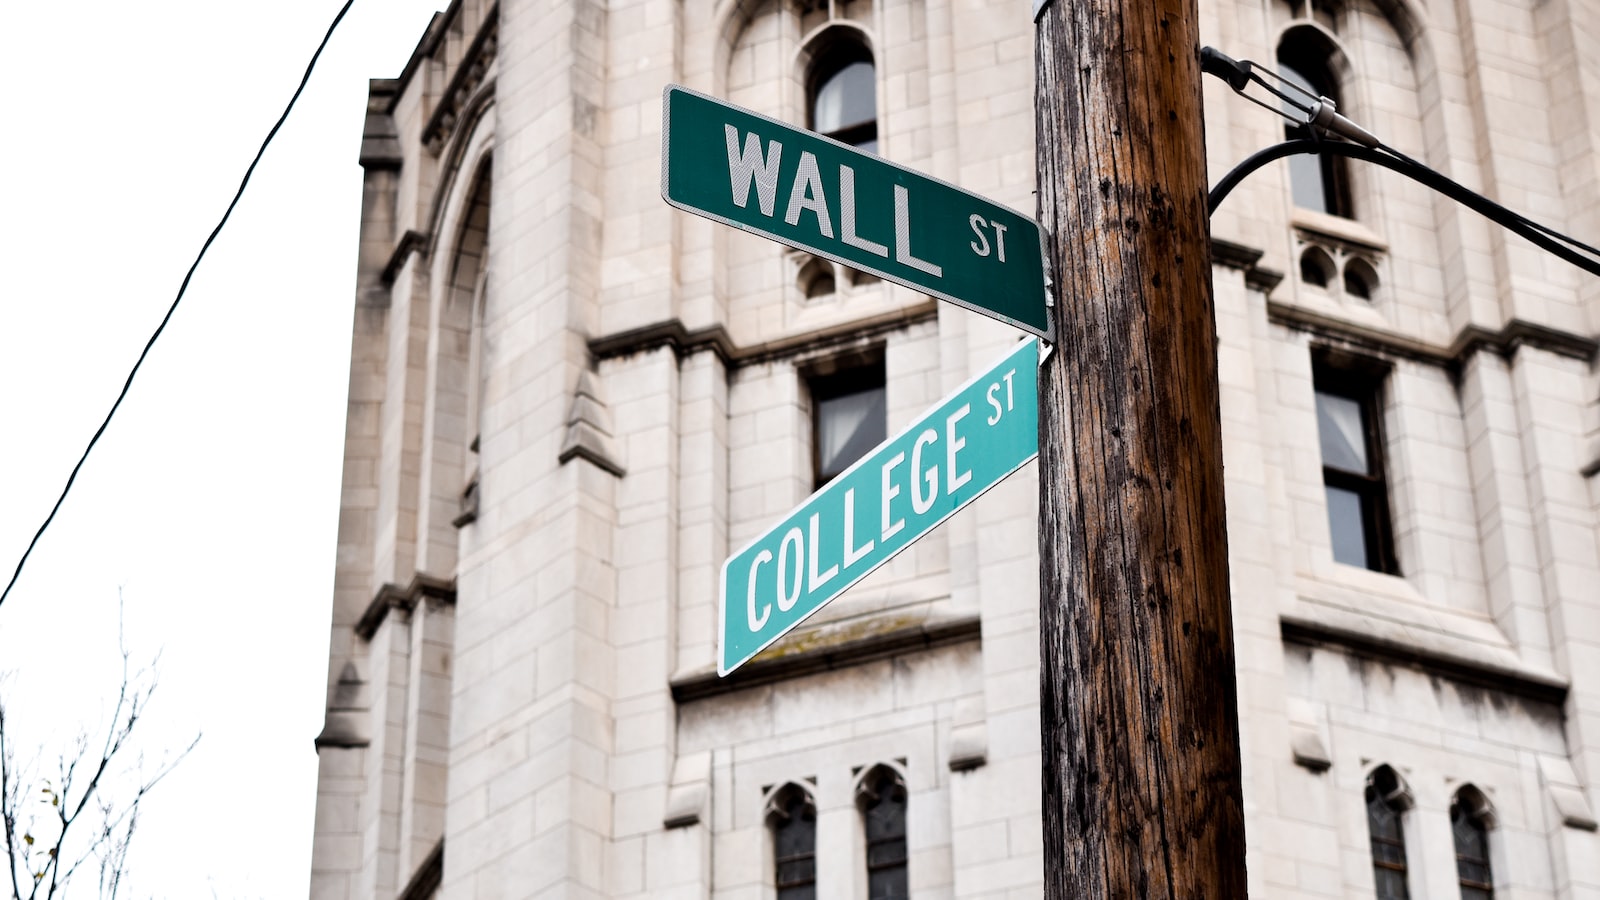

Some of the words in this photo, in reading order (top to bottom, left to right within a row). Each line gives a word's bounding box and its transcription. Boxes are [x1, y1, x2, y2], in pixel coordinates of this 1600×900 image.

[724, 123, 943, 278] WALL
[969, 213, 1008, 263] ST
[747, 402, 973, 633] COLLEGE
[986, 368, 1016, 427] ST
